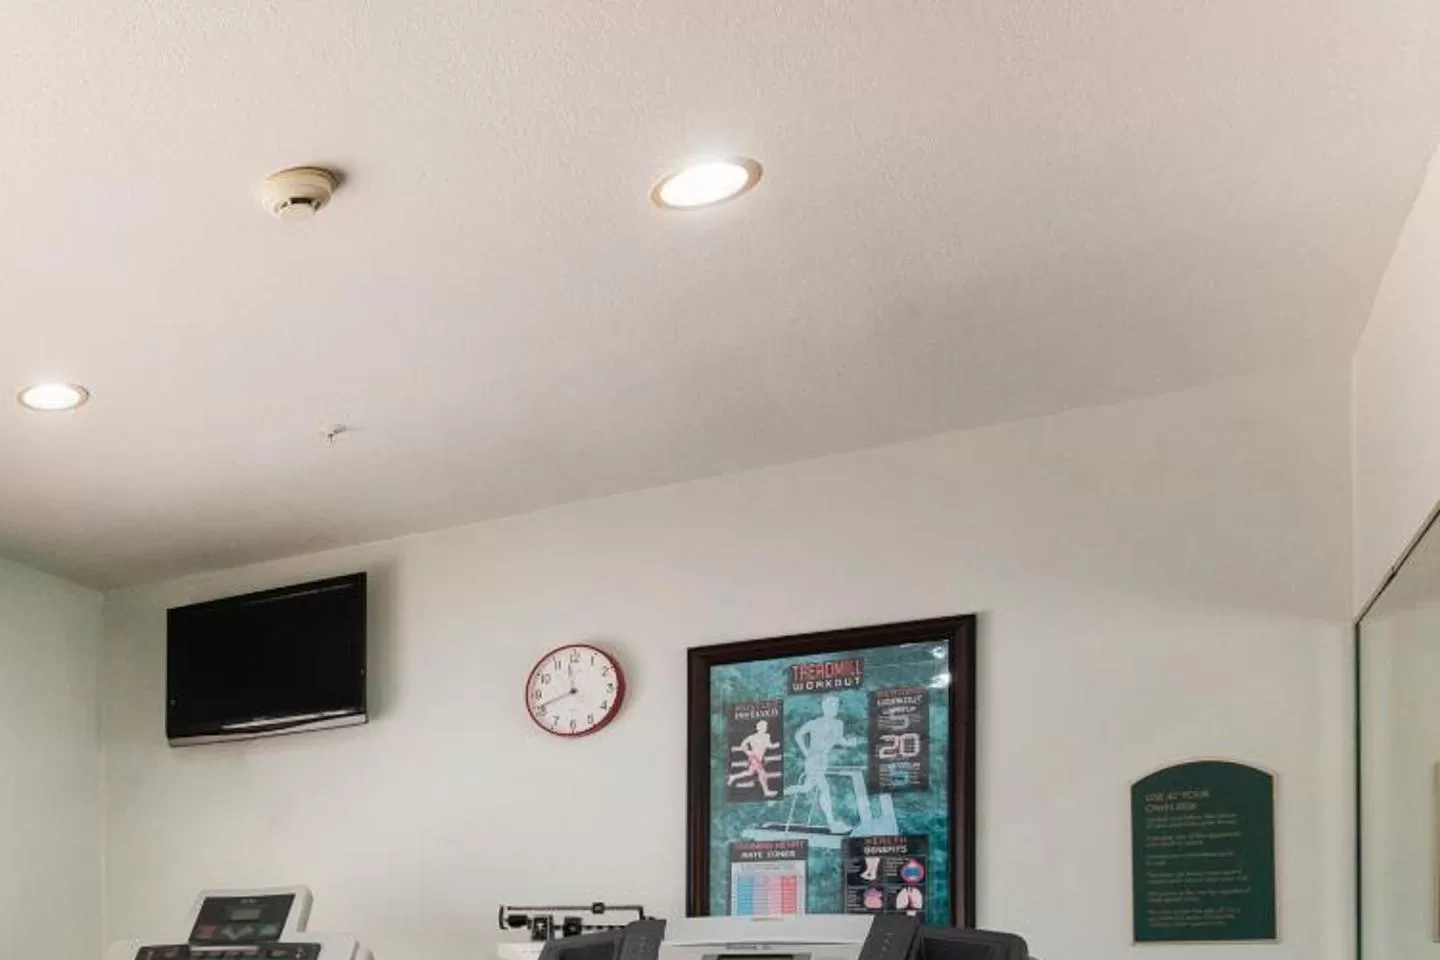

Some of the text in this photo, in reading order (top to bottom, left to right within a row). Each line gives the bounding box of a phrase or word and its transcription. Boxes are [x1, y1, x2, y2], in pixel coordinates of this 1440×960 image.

[792, 659, 863, 681] TREADML
[792, 676, 862, 692] WORKOUT
[878, 732, 921, 759] 20
